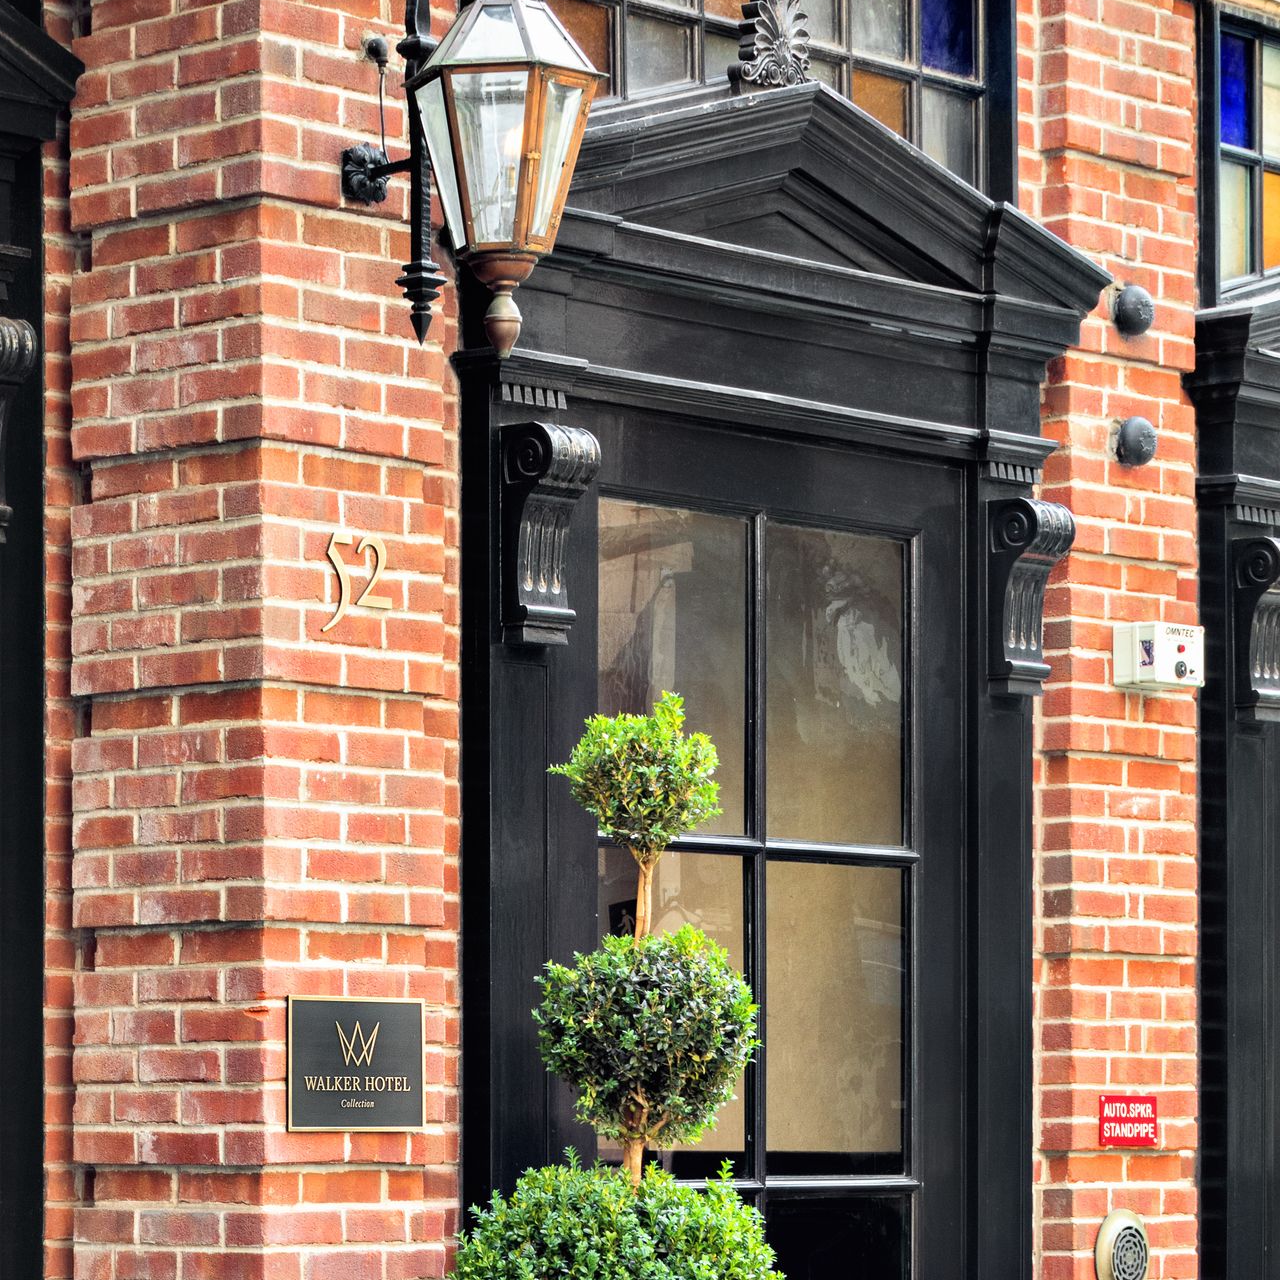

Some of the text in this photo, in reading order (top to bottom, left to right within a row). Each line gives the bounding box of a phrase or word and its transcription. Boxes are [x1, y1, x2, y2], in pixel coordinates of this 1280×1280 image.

[321, 531, 393, 632] 52
[304, 1075, 411, 1092] WALKER HOTEL
[341, 1098, 375, 1109] Collection
[1104, 1102, 1155, 1118] AUTO.SPKR.
[1103, 1122, 1155, 1138] STANDPIPE
